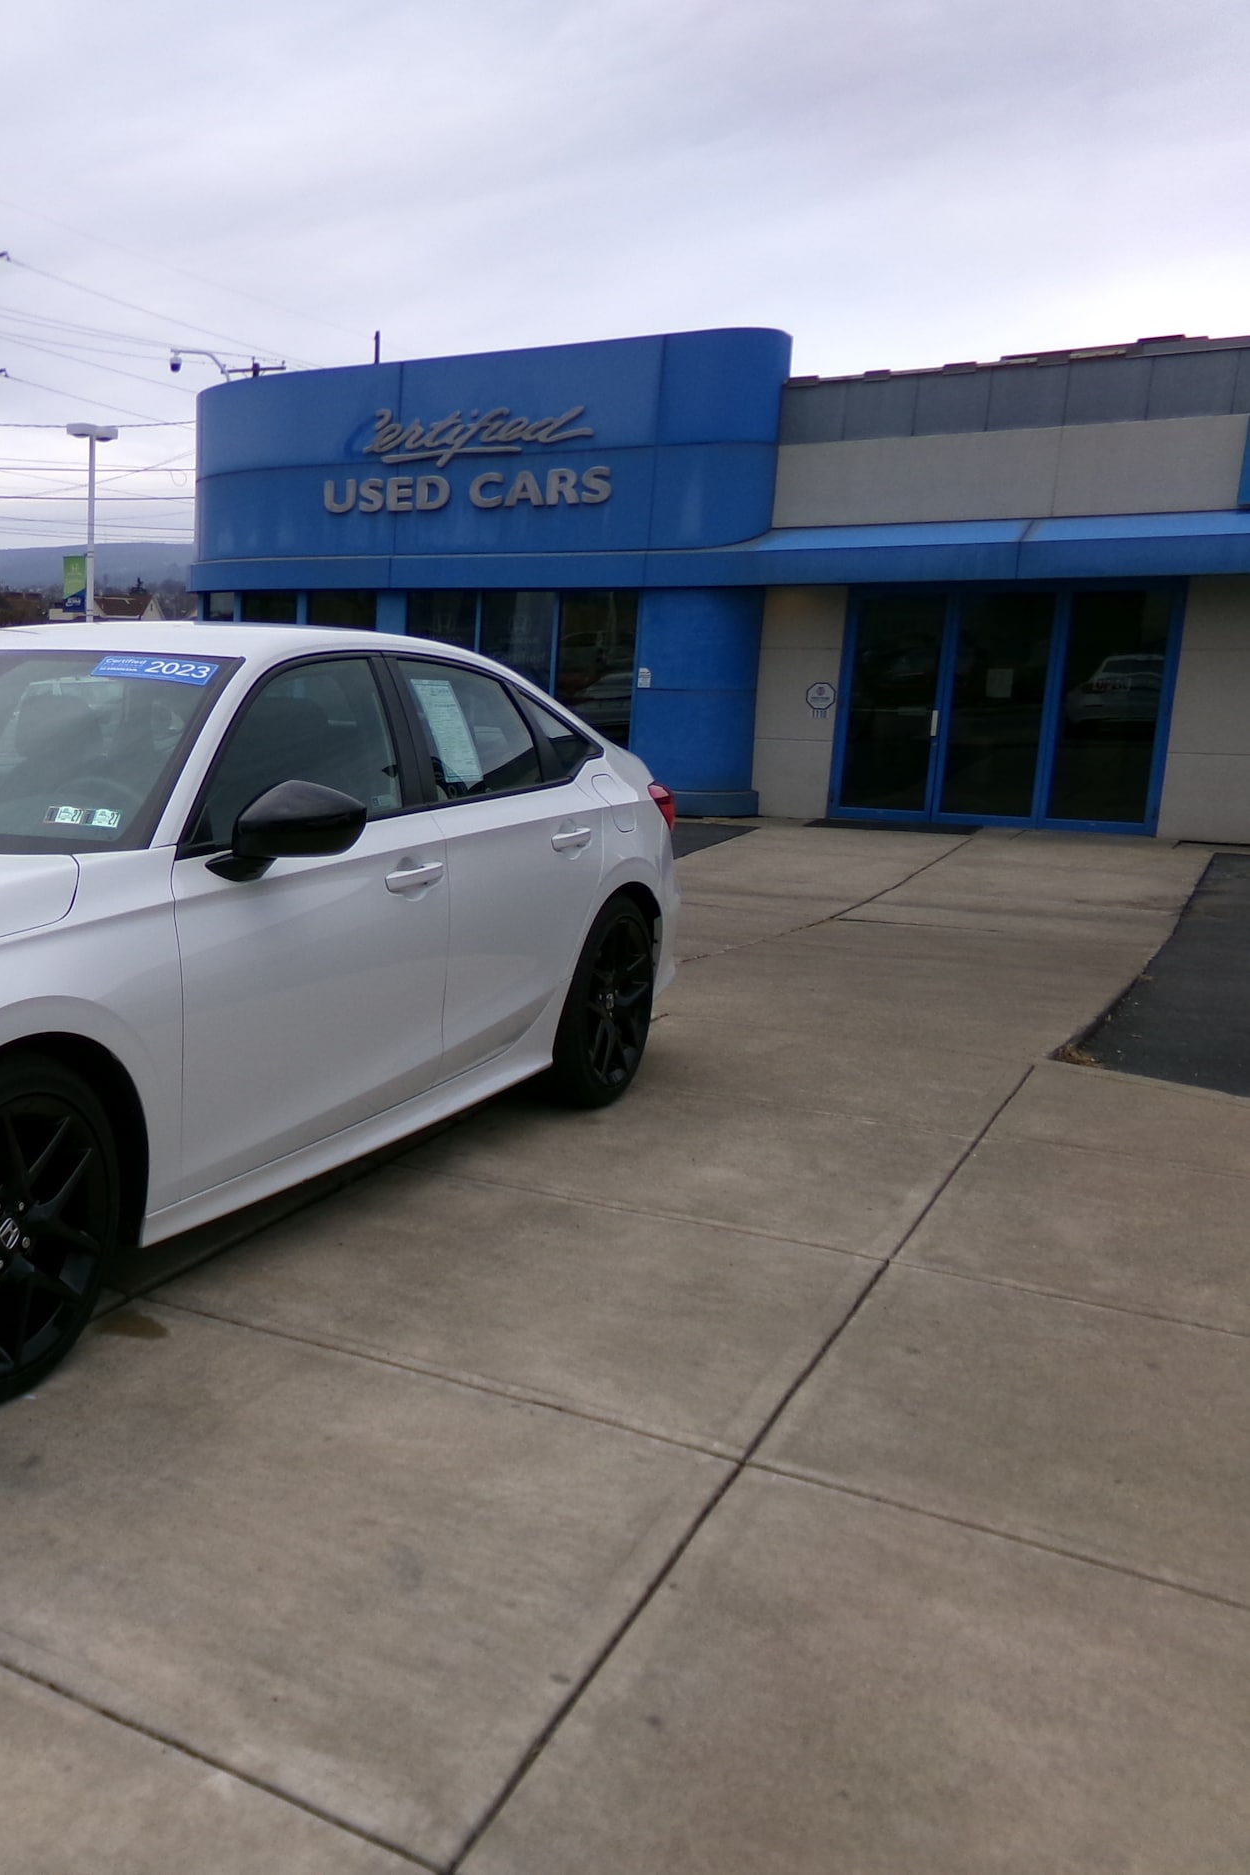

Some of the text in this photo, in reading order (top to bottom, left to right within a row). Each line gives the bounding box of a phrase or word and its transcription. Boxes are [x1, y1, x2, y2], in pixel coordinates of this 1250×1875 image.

[323, 466, 612, 513] USED CARS
[144, 661, 211, 679] 2023
